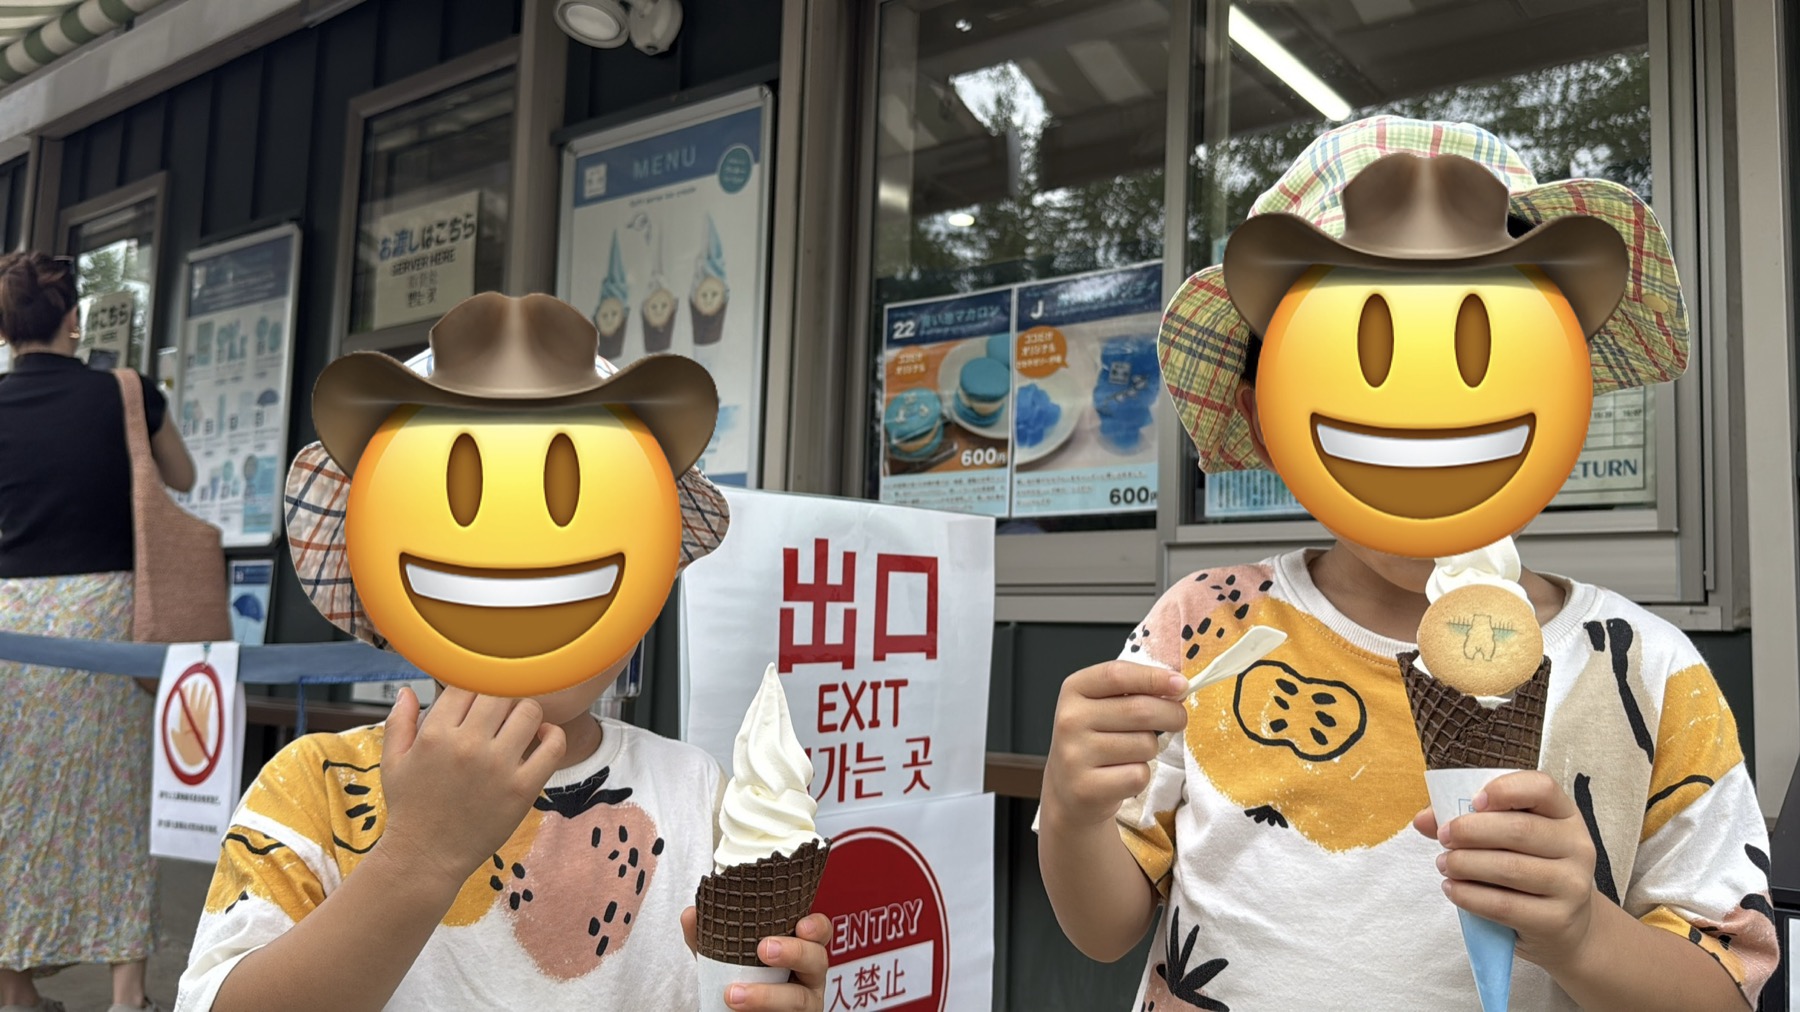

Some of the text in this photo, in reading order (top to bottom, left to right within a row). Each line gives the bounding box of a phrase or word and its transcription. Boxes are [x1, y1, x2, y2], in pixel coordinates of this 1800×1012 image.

[632, 145, 697, 180] MENU
[379, 212, 476, 261] お渡しはこちら
[893, 319, 916, 340] 22
[1030, 299, 1044, 319] J
[1022, 343, 1056, 357] オリジナル
[778, 538, 939, 674] 出口
[817, 678, 909, 734] EXIT
[804, 735, 933, 803] 가는 곳
[830, 898, 924, 957] ENTRY
